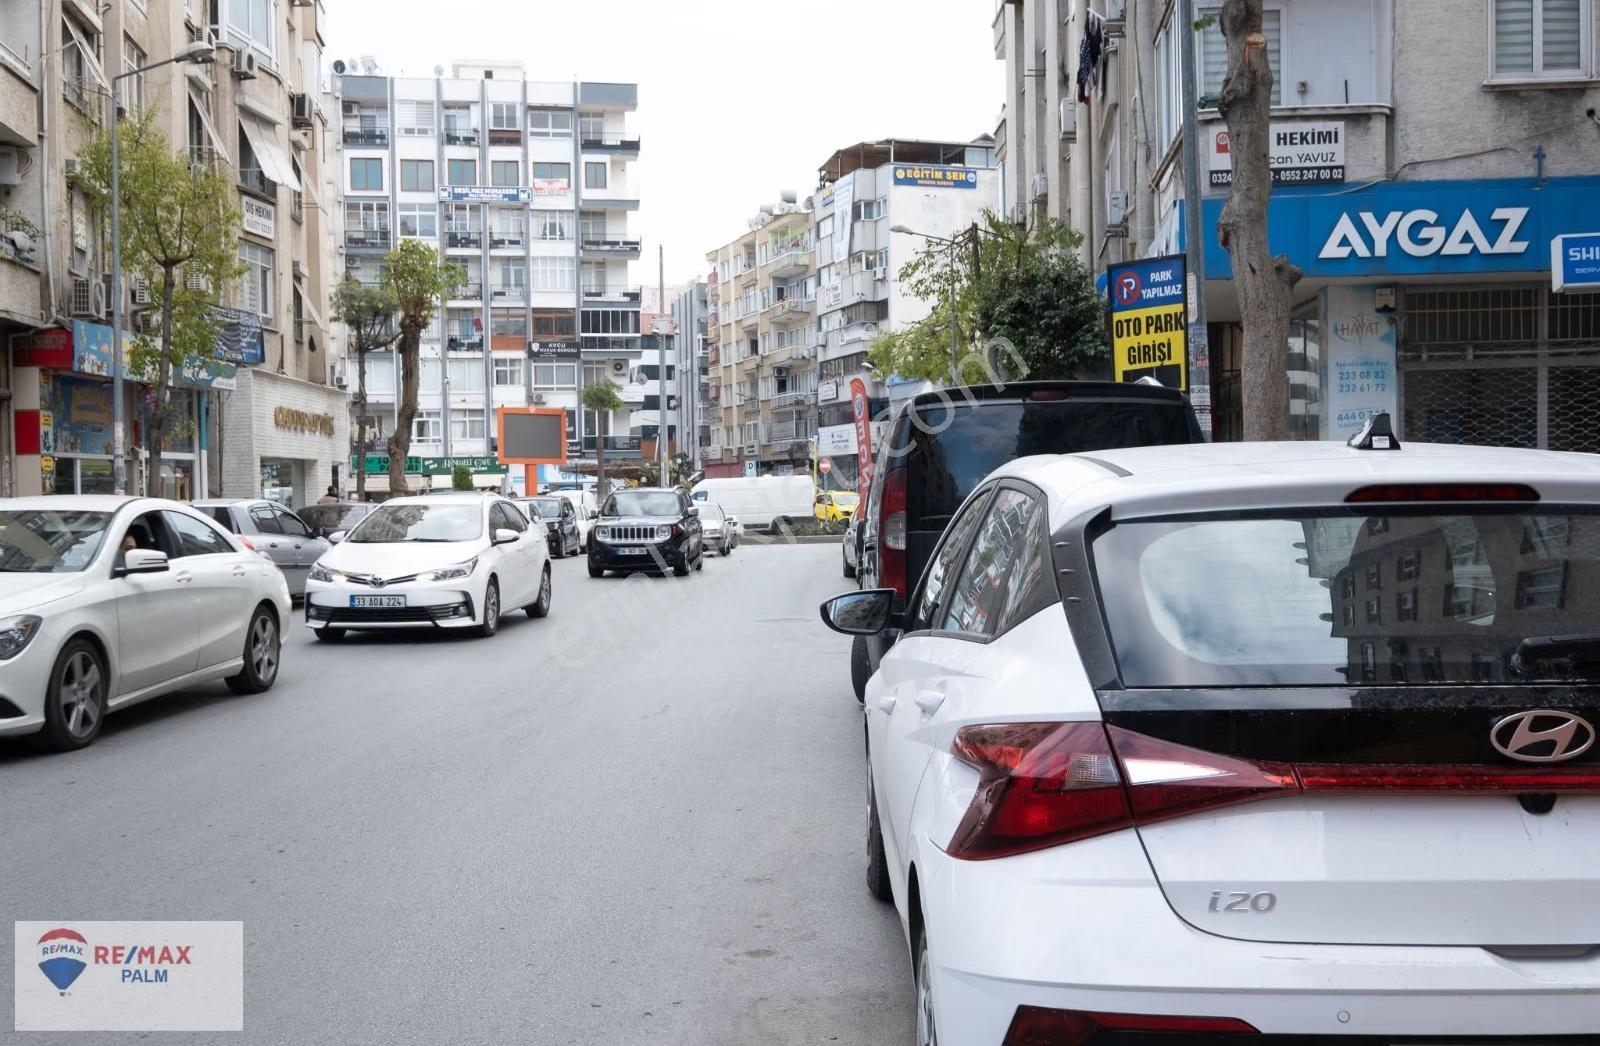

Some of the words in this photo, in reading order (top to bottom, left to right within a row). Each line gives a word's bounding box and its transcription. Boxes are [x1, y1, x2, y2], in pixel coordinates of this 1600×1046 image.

[1276, 128, 1339, 146] HEKİMİ
[1268, 154, 1293, 165] can
[1296, 152, 1336, 164] YAVUZ
[906, 167, 943, 180] EĞİTİM
[945, 170, 966, 181] SEN
[1211, 172, 1232, 183] 0324
[1280, 170, 1301, 181] 0552
[1302, 169, 1318, 180] 247
[1319, 169, 1331, 179] 00
[1332, 168, 1343, 179] 02
[1318, 207, 1530, 259] AYGAZ
[1150, 270, 1172, 283] PARK
[1141, 284, 1183, 300] YAPILMAZ
[1115, 316, 1142, 339] OTO
[1145, 311, 1185, 335] PARK
[1340, 321, 1380, 337] HAYAT
[1127, 338, 1172, 366] GİRİŞİ
[1338, 371, 1356, 380] 233
[1338, 383, 1357, 393] 232
[1359, 383, 1370, 393] 61
[1374, 383, 1386, 392] 72
[1337, 412, 1356, 422] 444
[355, 597, 365, 607] 33
[386, 597, 402, 607] 224
[1207, 889, 1278, 915] i20
